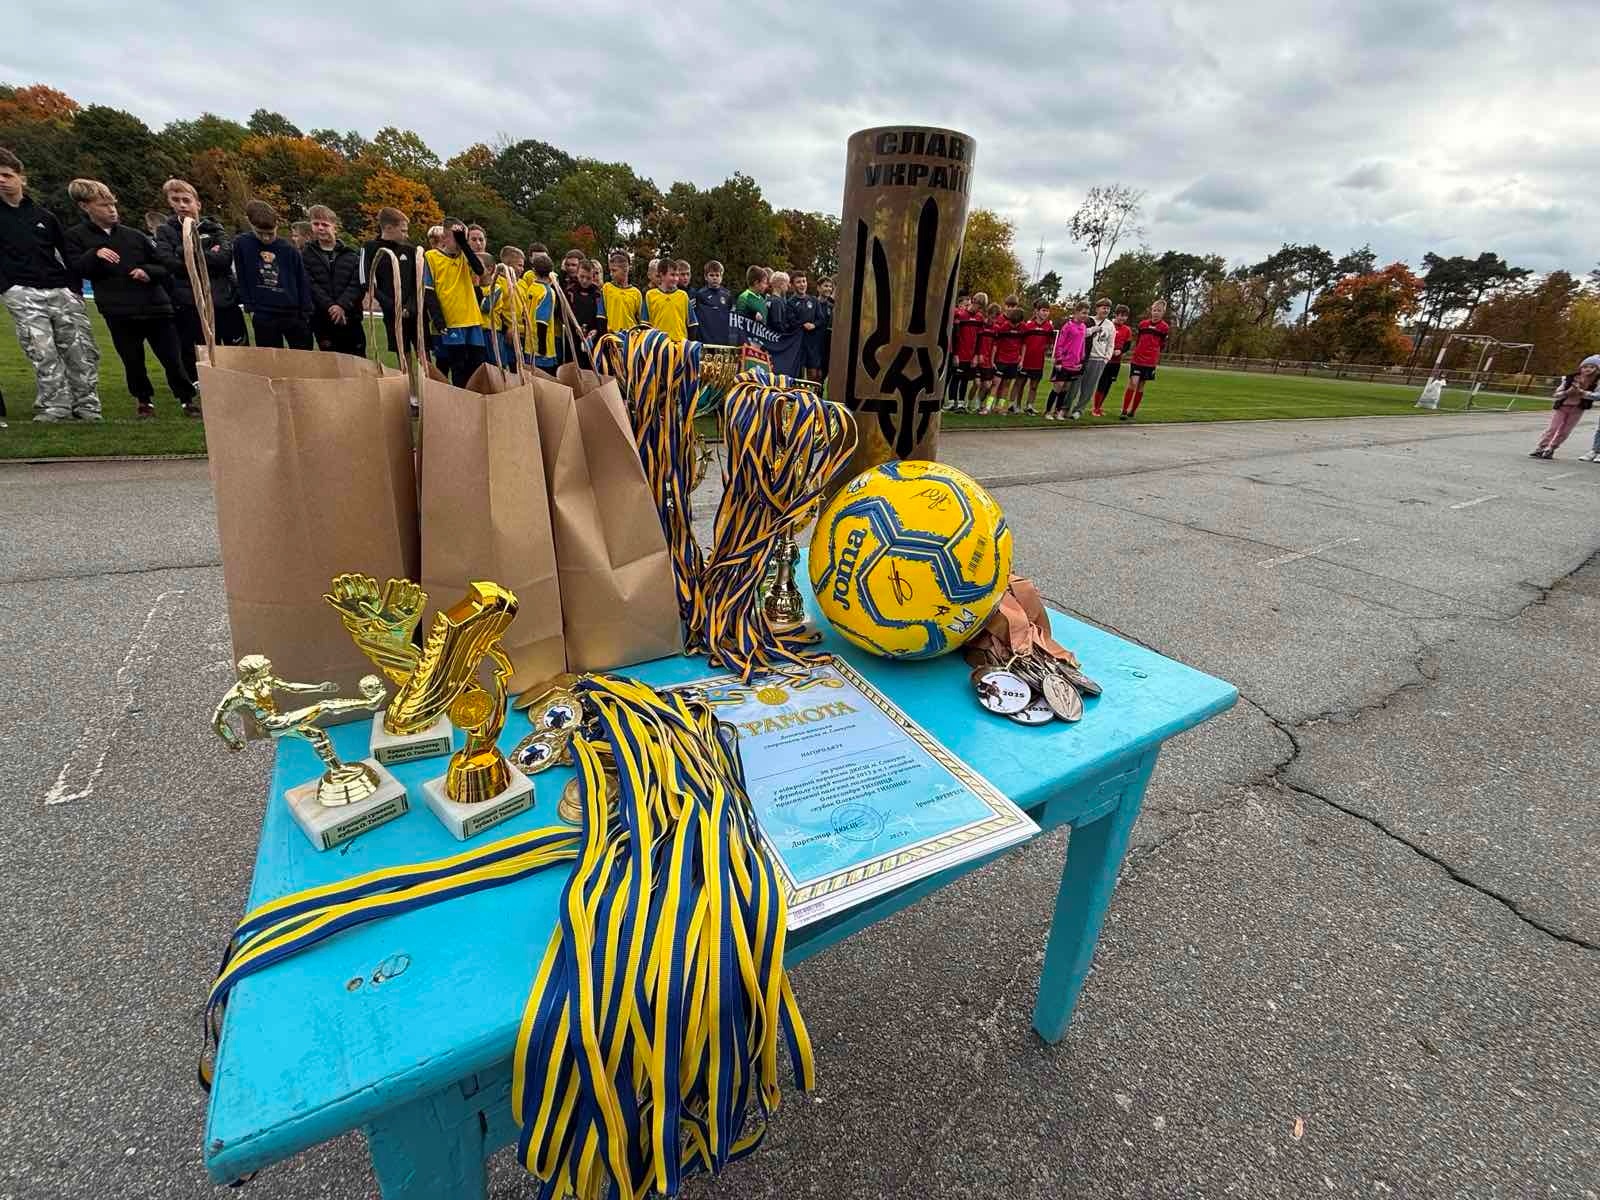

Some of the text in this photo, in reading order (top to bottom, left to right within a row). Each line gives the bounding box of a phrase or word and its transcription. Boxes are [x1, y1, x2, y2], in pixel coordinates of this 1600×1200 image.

[878, 131, 967, 161] СЛАВ
[1002, 690, 1025, 699] 2025
[791, 831, 832, 849] Директор
